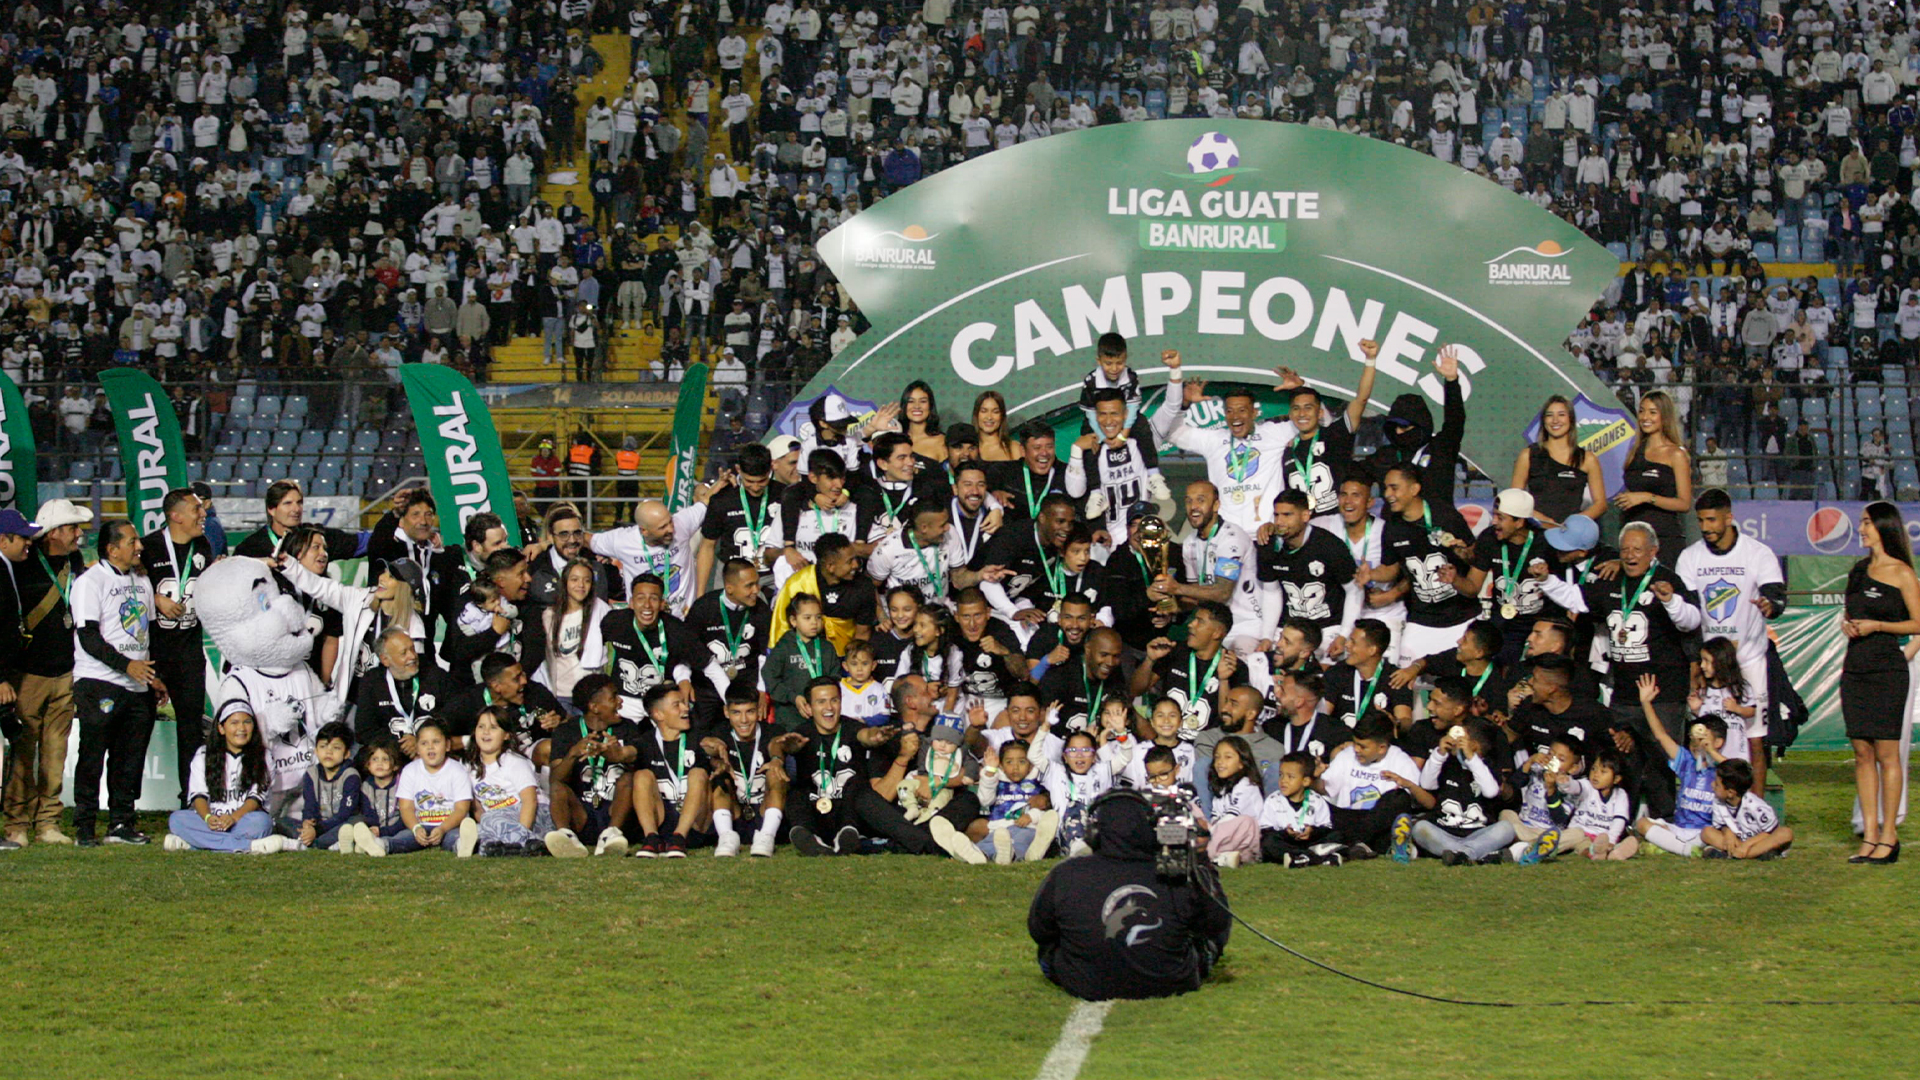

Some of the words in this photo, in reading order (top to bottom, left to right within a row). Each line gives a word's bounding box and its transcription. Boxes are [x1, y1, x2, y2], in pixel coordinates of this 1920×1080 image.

[1108, 188, 1193, 217] LIGA
[1200, 189, 1320, 220] GUATE
[1149, 222, 1275, 250] BANRURAL
[856, 247, 936, 265] BANRURAL
[1488, 263, 1572, 280] BANRURAL
[951, 270, 1487, 406] CAMPEONES
[1109, 450, 1129, 463] tigo
[1109, 464, 1134, 480] RAFA
[1696, 566, 1746, 577] CAMPEONES
